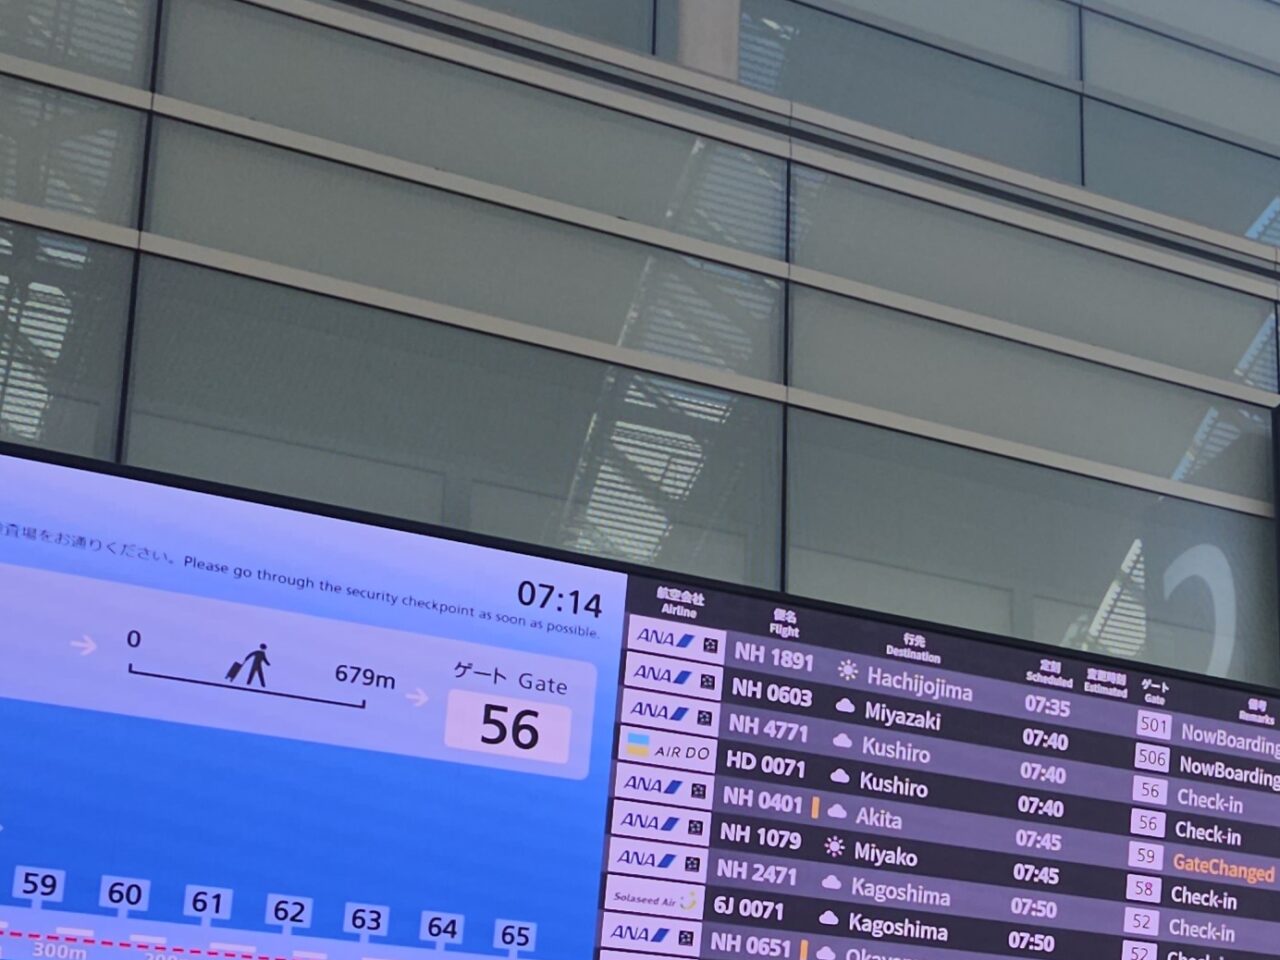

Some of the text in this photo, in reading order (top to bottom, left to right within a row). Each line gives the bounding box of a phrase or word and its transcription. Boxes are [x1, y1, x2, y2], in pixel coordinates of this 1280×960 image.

[0, 522, 174, 564] 査場をお通りください。
[184, 555, 600, 640] Please go through the security checkpoint as soon as possible.
[517, 580, 601, 618] 07:14
[126, 630, 394, 689] 0 679m
[661, 603, 696, 618] Airline
[769, 622, 799, 638] Flight
[886, 644, 940, 664] Destination
[454, 661, 567, 694] ゲート Gate
[636, 628, 678, 646] ANA
[734, 641, 764, 663] NH
[771, 648, 813, 671] 1891
[868, 666, 972, 701] Hachijojima
[1024, 694, 1070, 717] 07:35
[1141, 716, 1165, 732] 501
[481, 703, 538, 749] 56
[623, 774, 1274, 883] ANA NH 0401 Akita 07:45 59 GateChanged
[22, 872, 529, 946] 59 60 61 62 63 64 65
[714, 896, 734, 914] 6J
[739, 898, 783, 920] 0071
[849, 912, 947, 940] Kagoshima
[1008, 931, 1054, 951] 07:50
[33, 941, 86, 959] 300m
